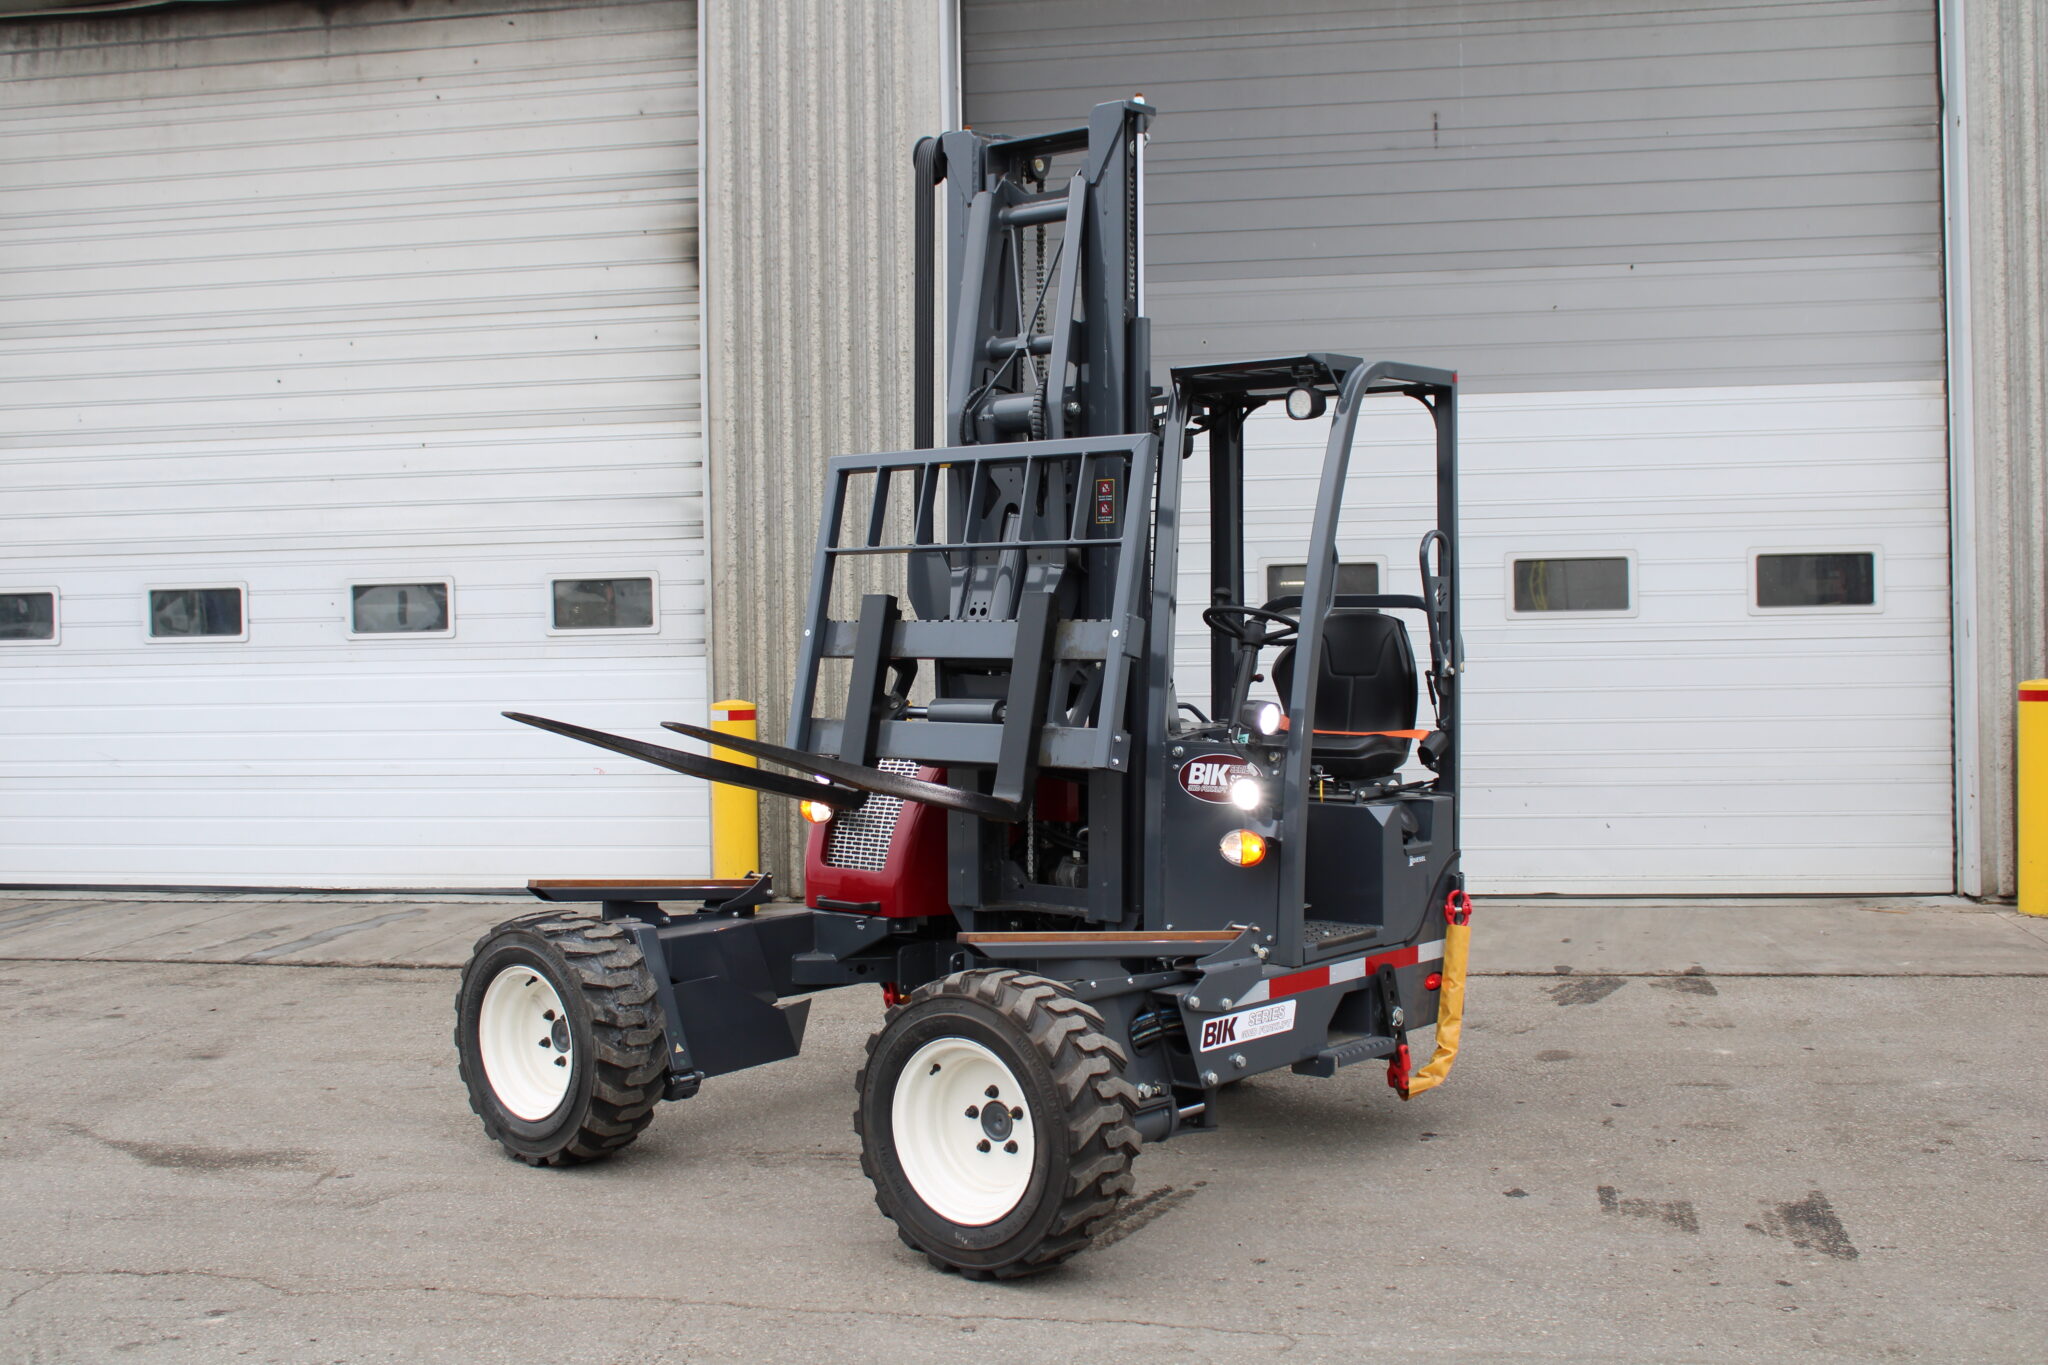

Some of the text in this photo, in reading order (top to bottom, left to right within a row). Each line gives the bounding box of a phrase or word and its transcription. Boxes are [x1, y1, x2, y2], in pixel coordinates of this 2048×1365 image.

[1188, 763, 1231, 786] BIK
[1203, 1005, 1286, 1049] BIK SERIES
